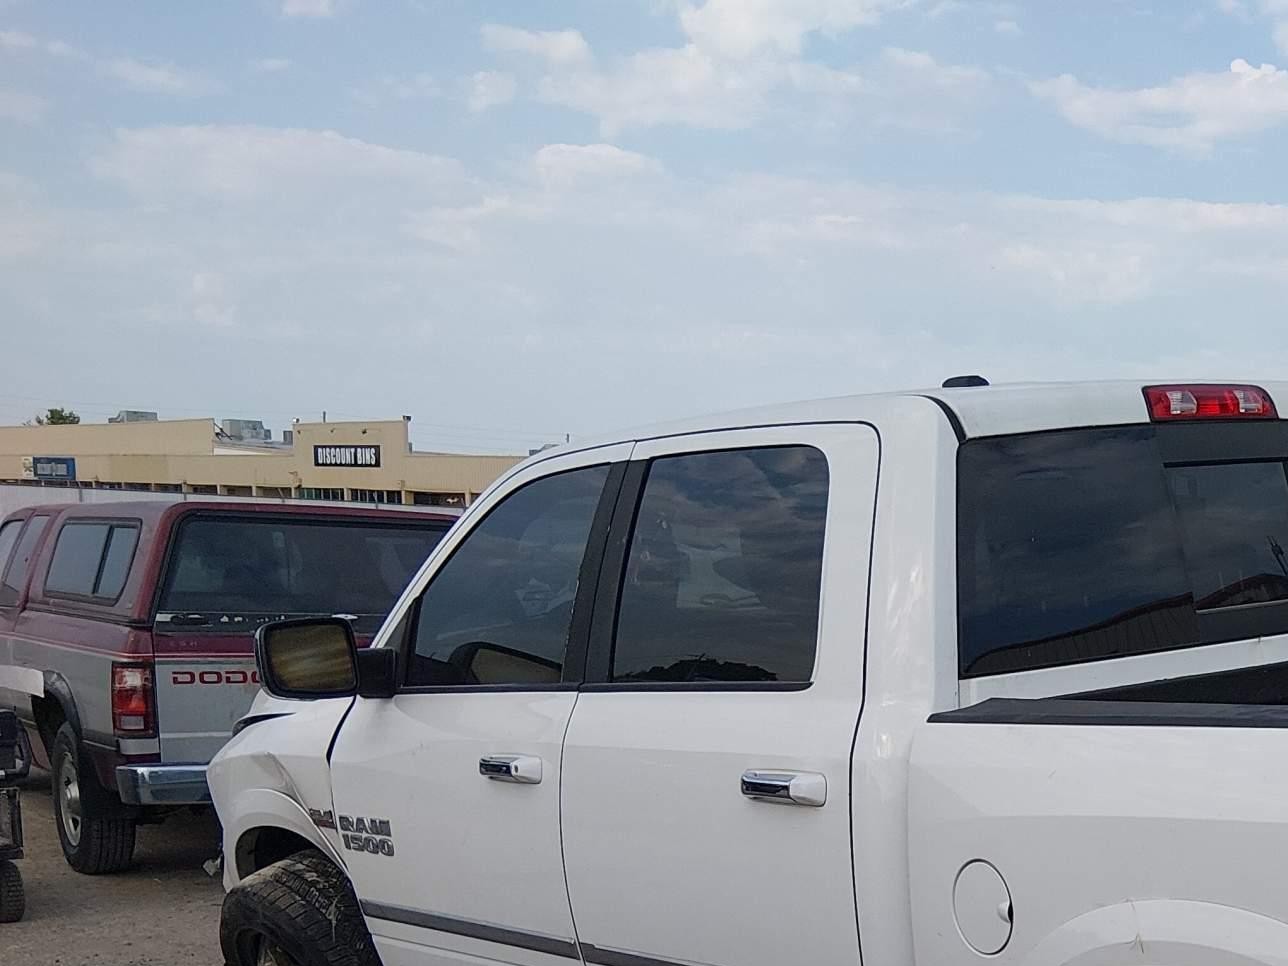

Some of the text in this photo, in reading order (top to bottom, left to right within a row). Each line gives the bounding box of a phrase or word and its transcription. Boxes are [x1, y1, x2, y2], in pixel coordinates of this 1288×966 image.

[317, 447, 376, 465] DISCOUNT BINS
[338, 815, 392, 837] RAM
[341, 834, 395, 857] 1500
